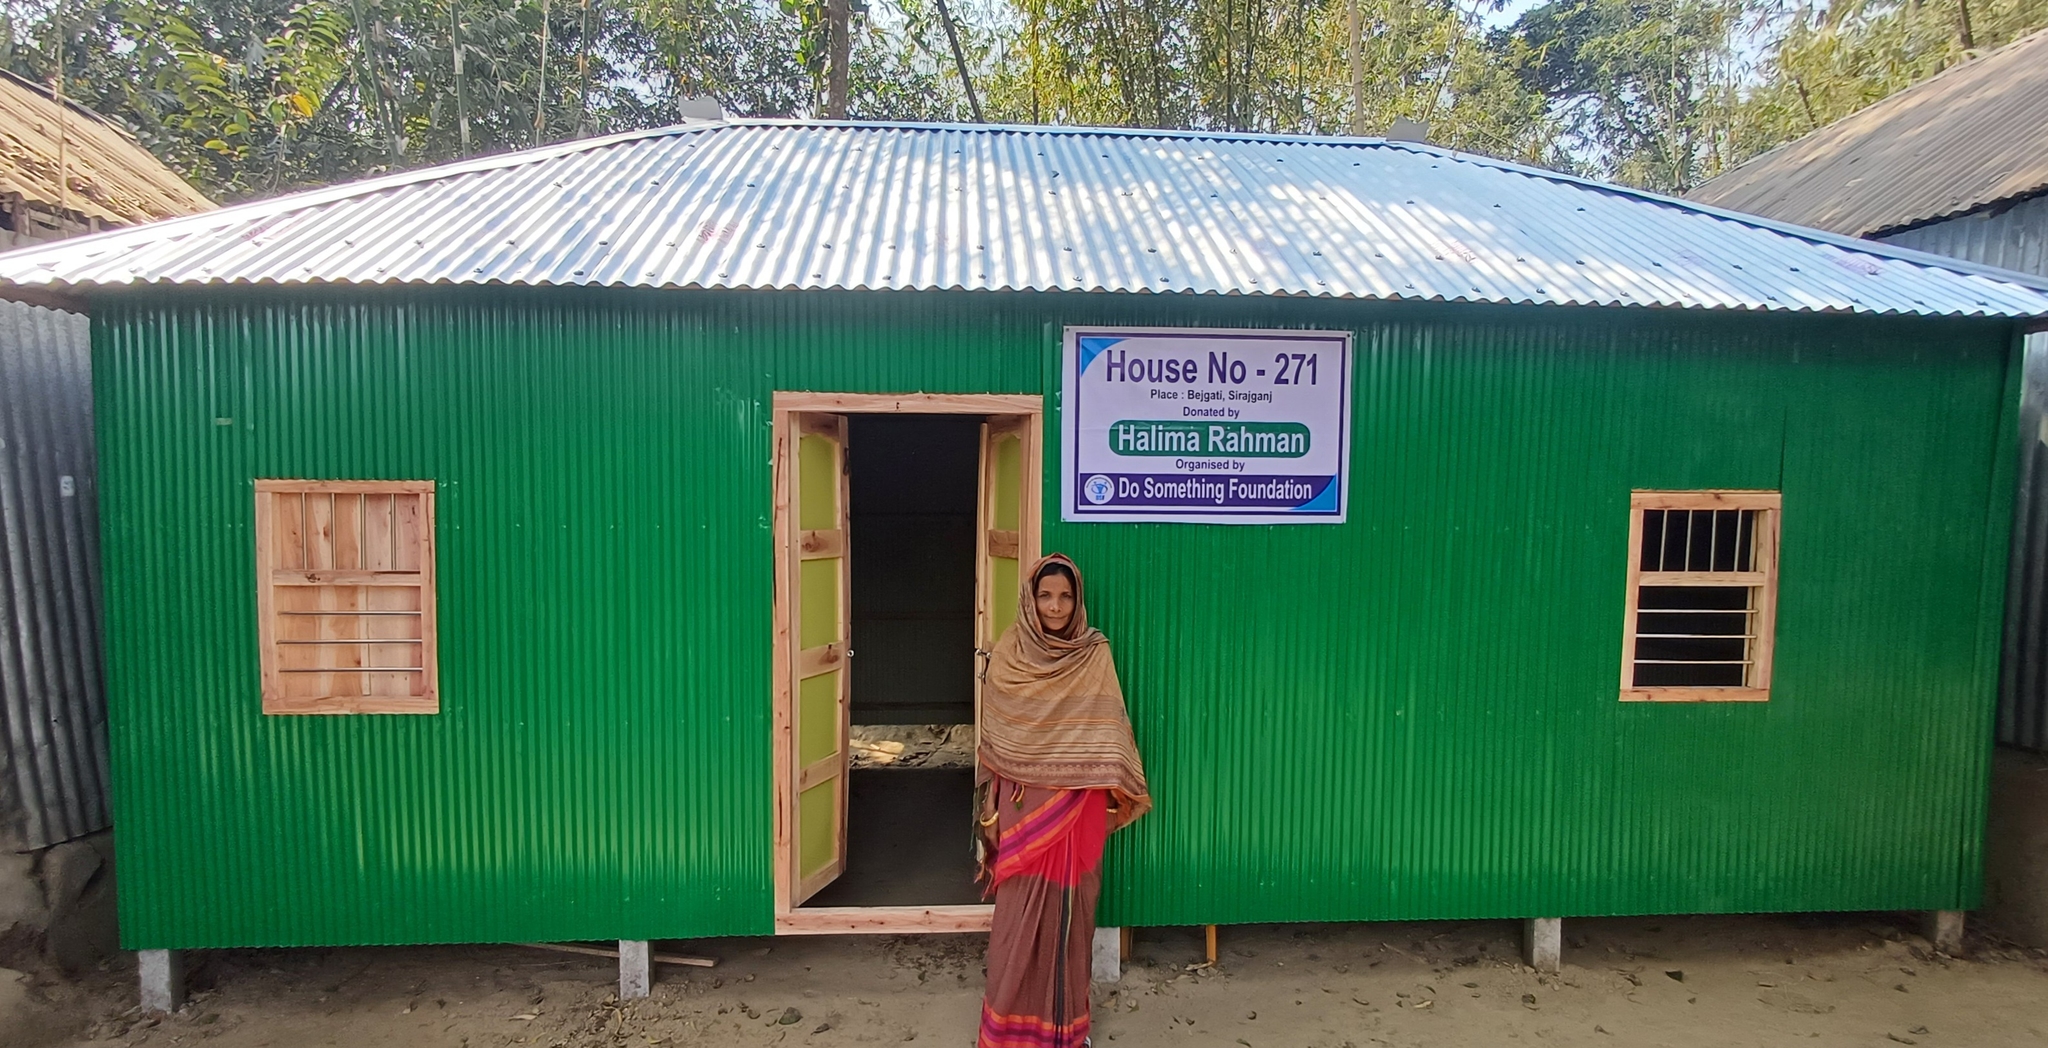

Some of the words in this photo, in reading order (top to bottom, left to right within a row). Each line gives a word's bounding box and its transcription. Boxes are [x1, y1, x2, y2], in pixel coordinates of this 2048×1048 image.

[1106, 350, 1198, 383] House
[1208, 352, 1246, 384] No
[1273, 353, 1317, 385] 271
[1150, 389, 1178, 400] Place
[1187, 390, 1226, 403] Bejgati,
[1228, 390, 1272, 403] Sirajganj
[1183, 406, 1225, 417] Donated
[1226, 407, 1240, 419] by
[1118, 424, 1200, 452] Halima
[1208, 425, 1305, 453] Rahman
[1175, 458, 1229, 471] Organised
[1232, 459, 1245, 472] by
[1118, 477, 1139, 498] Do
[1144, 477, 1224, 504] Something
[1229, 478, 1312, 500] Foundation
